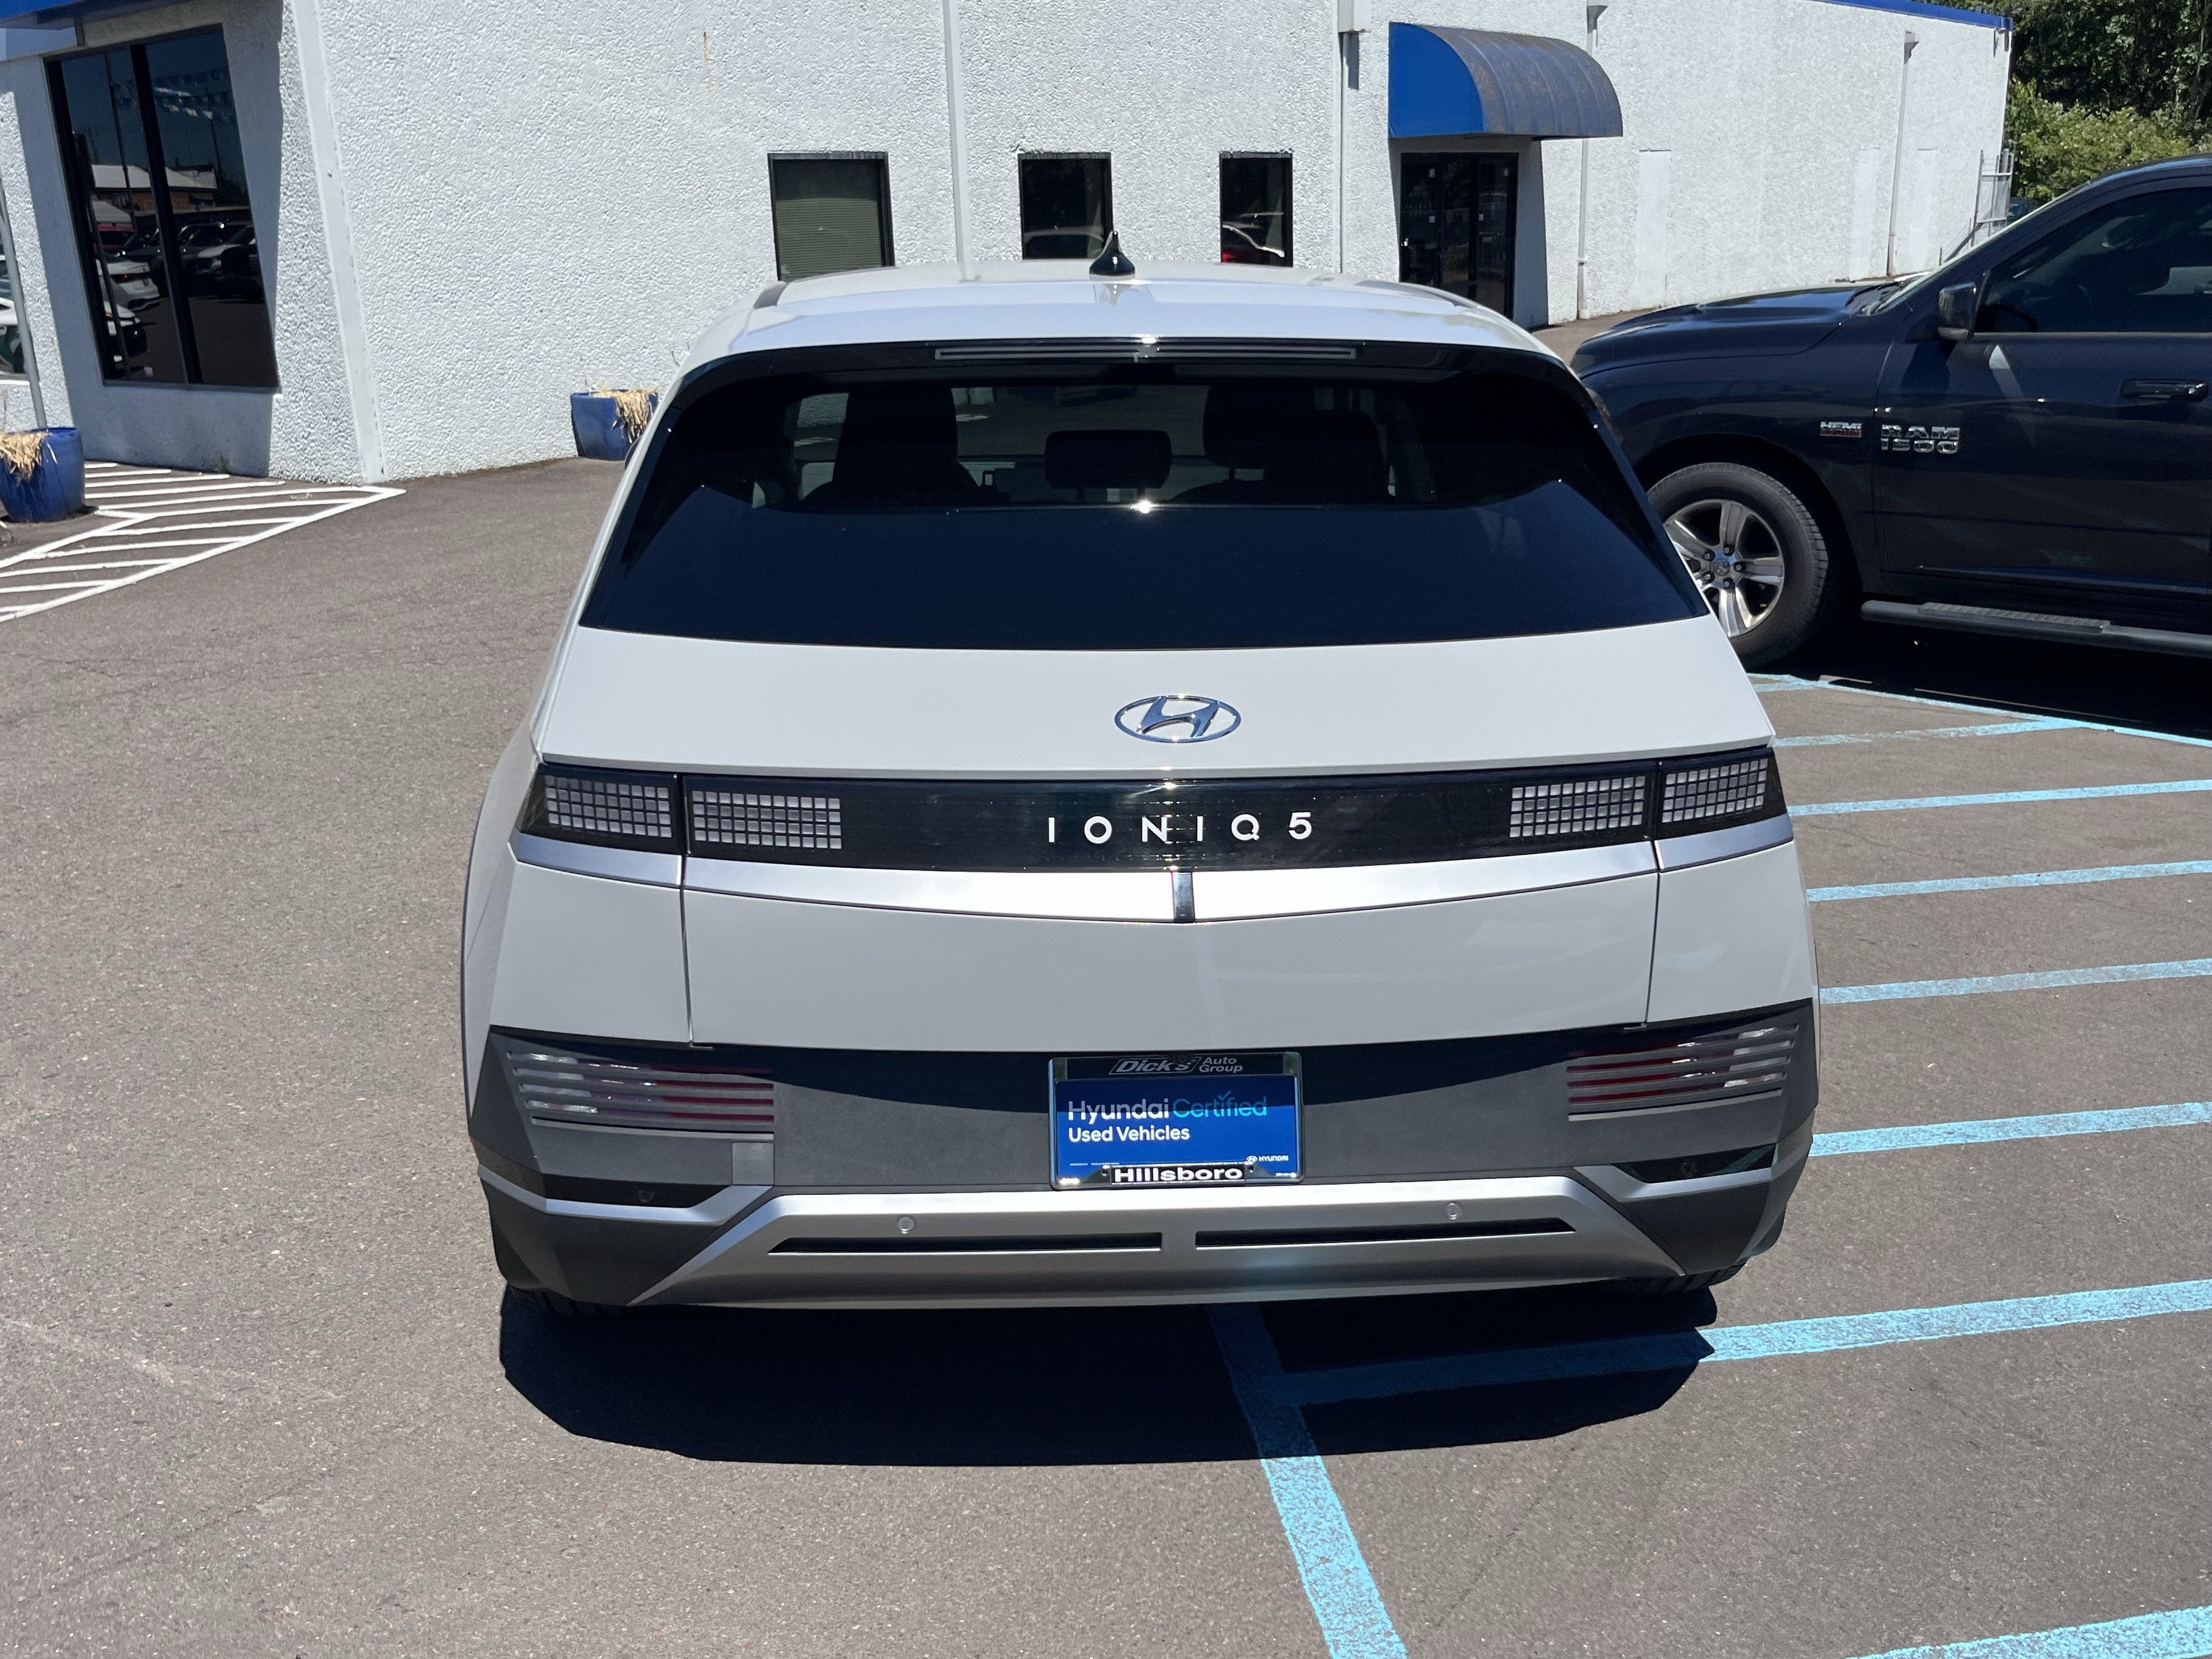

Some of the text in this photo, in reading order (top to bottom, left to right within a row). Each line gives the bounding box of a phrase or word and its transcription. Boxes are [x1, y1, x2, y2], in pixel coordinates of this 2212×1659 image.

[1881, 424, 1960, 439] RAM
[1880, 438, 1958, 454] 1500
[1048, 812, 1312, 844] IONIQ 5
[1116, 1059, 1192, 1073] Dicks
[1199, 1065, 1243, 1073] Group
[1203, 1057, 1237, 1065] Auto
[1068, 1095, 1267, 1124] Hyundai Certified
[1068, 1124, 1190, 1143] Used Vehicles
[1114, 1166, 1243, 1183] Hillsboro
